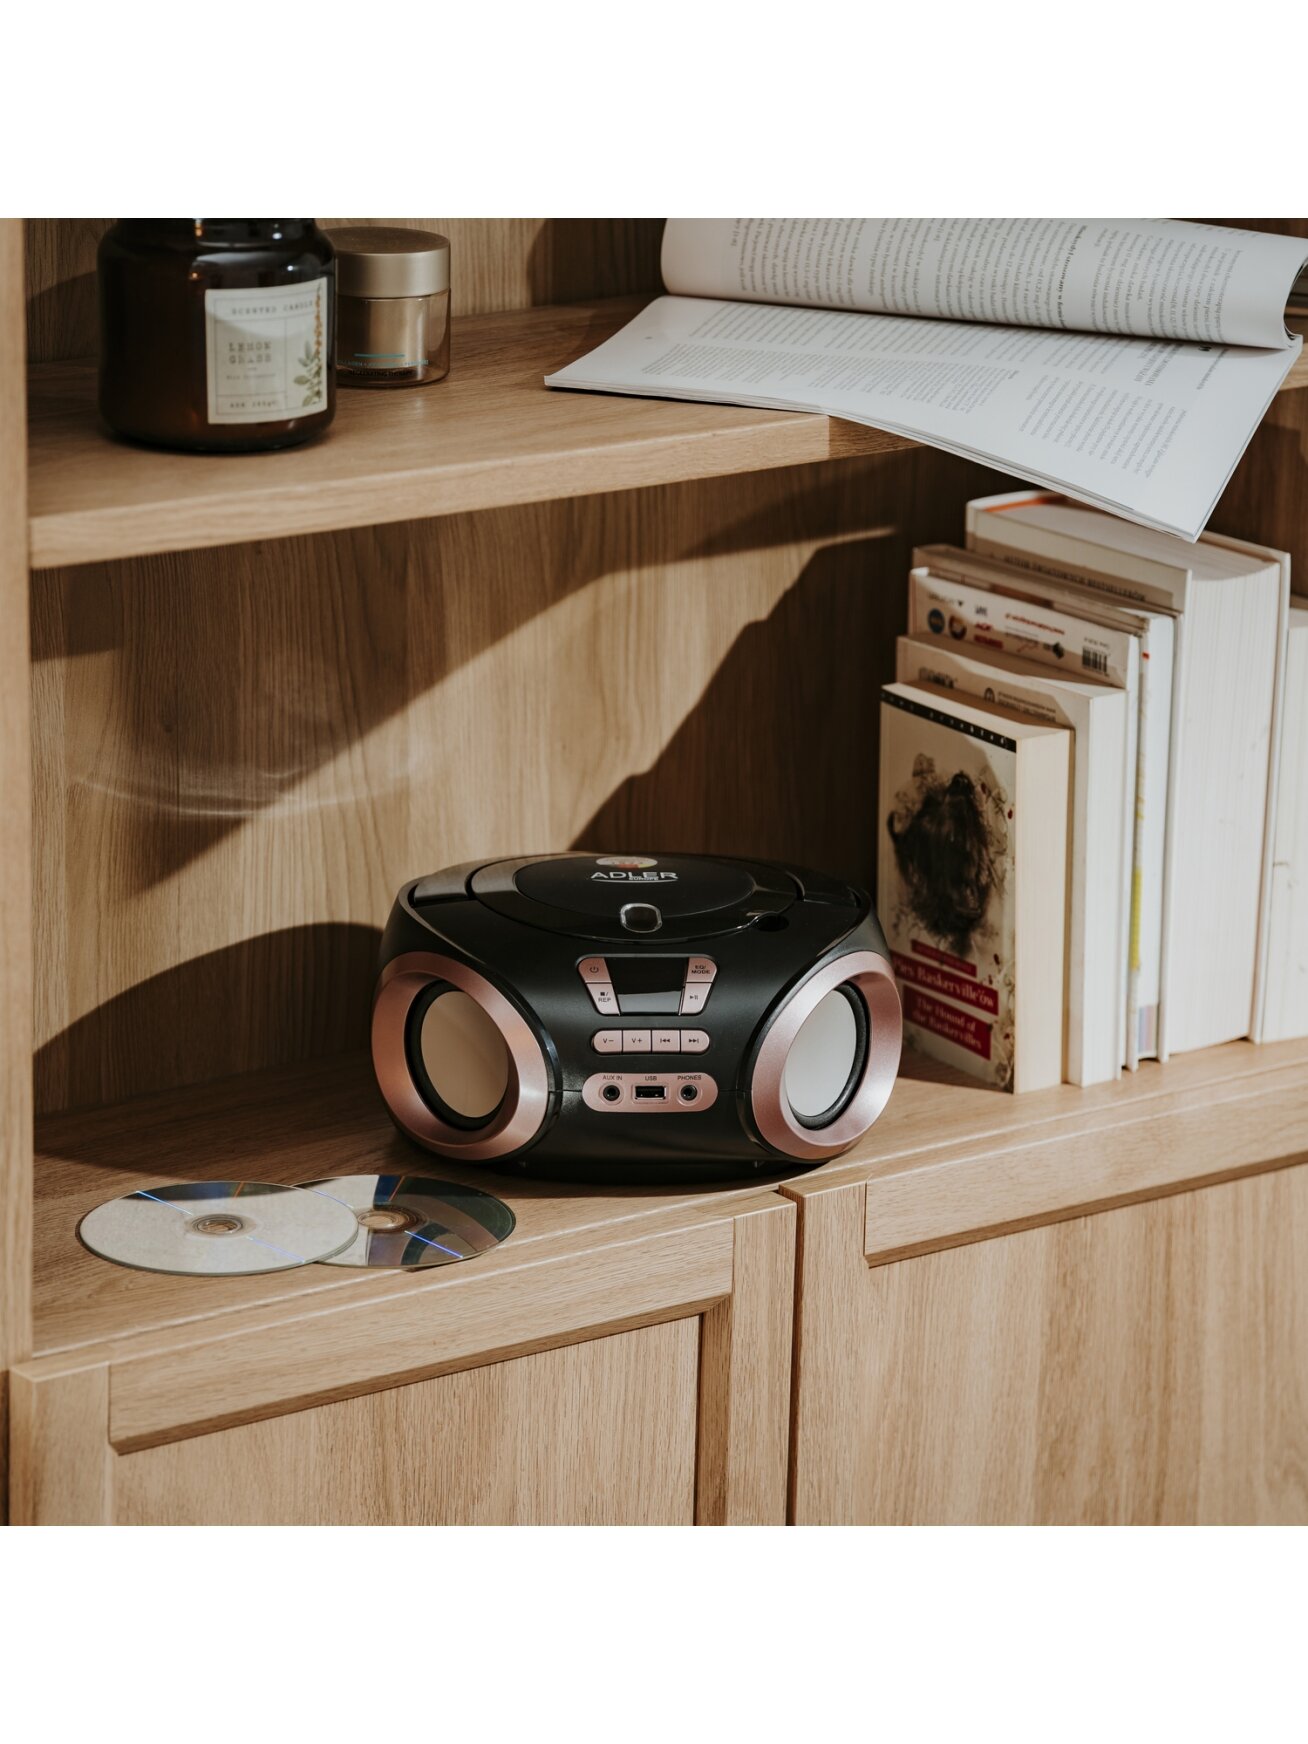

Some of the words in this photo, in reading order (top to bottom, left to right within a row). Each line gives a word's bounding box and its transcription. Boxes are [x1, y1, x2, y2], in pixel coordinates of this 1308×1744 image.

[228, 341, 272, 352] LEMON
[228, 353, 272, 365] GRASS
[590, 871, 678, 880] ADLER
